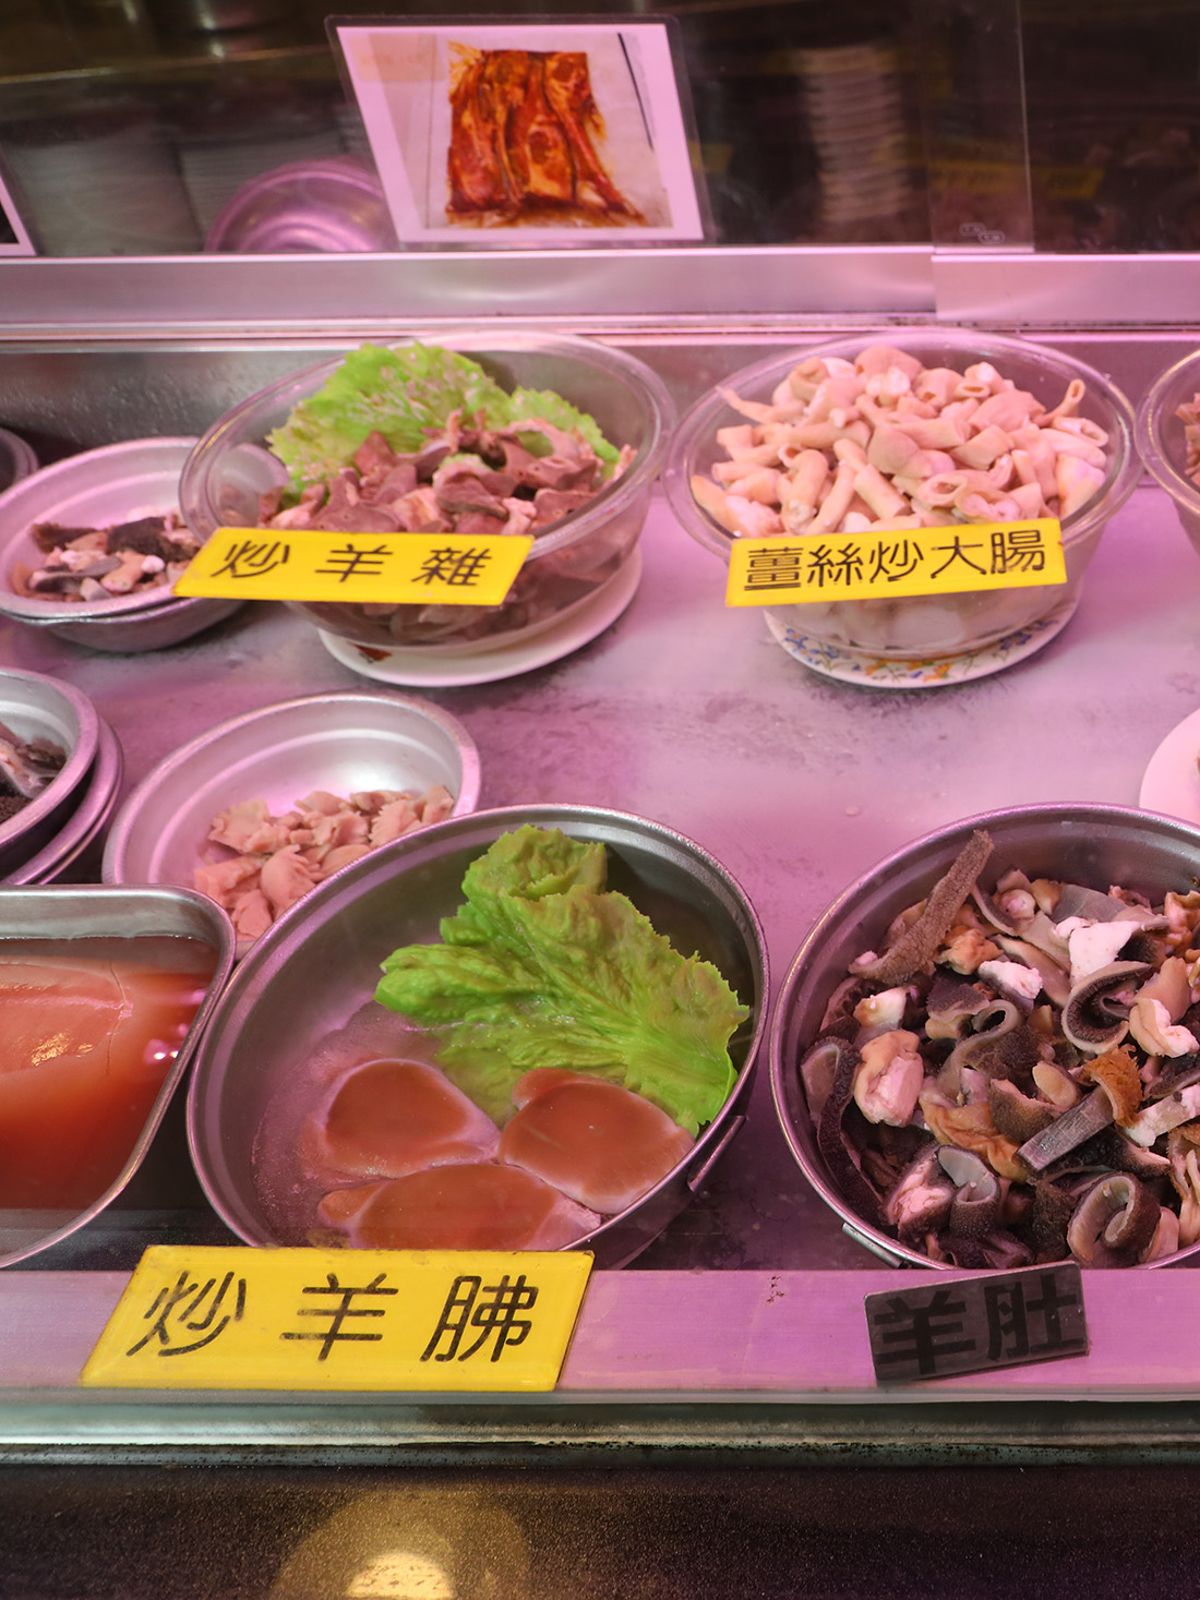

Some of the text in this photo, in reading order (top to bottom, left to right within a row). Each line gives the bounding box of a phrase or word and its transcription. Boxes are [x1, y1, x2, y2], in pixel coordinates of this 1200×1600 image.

[211, 539, 492, 586] 炒羊雜
[744, 530, 1046, 591] 薑絲炒大腸
[874, 1273, 1085, 1375] 羊肚
